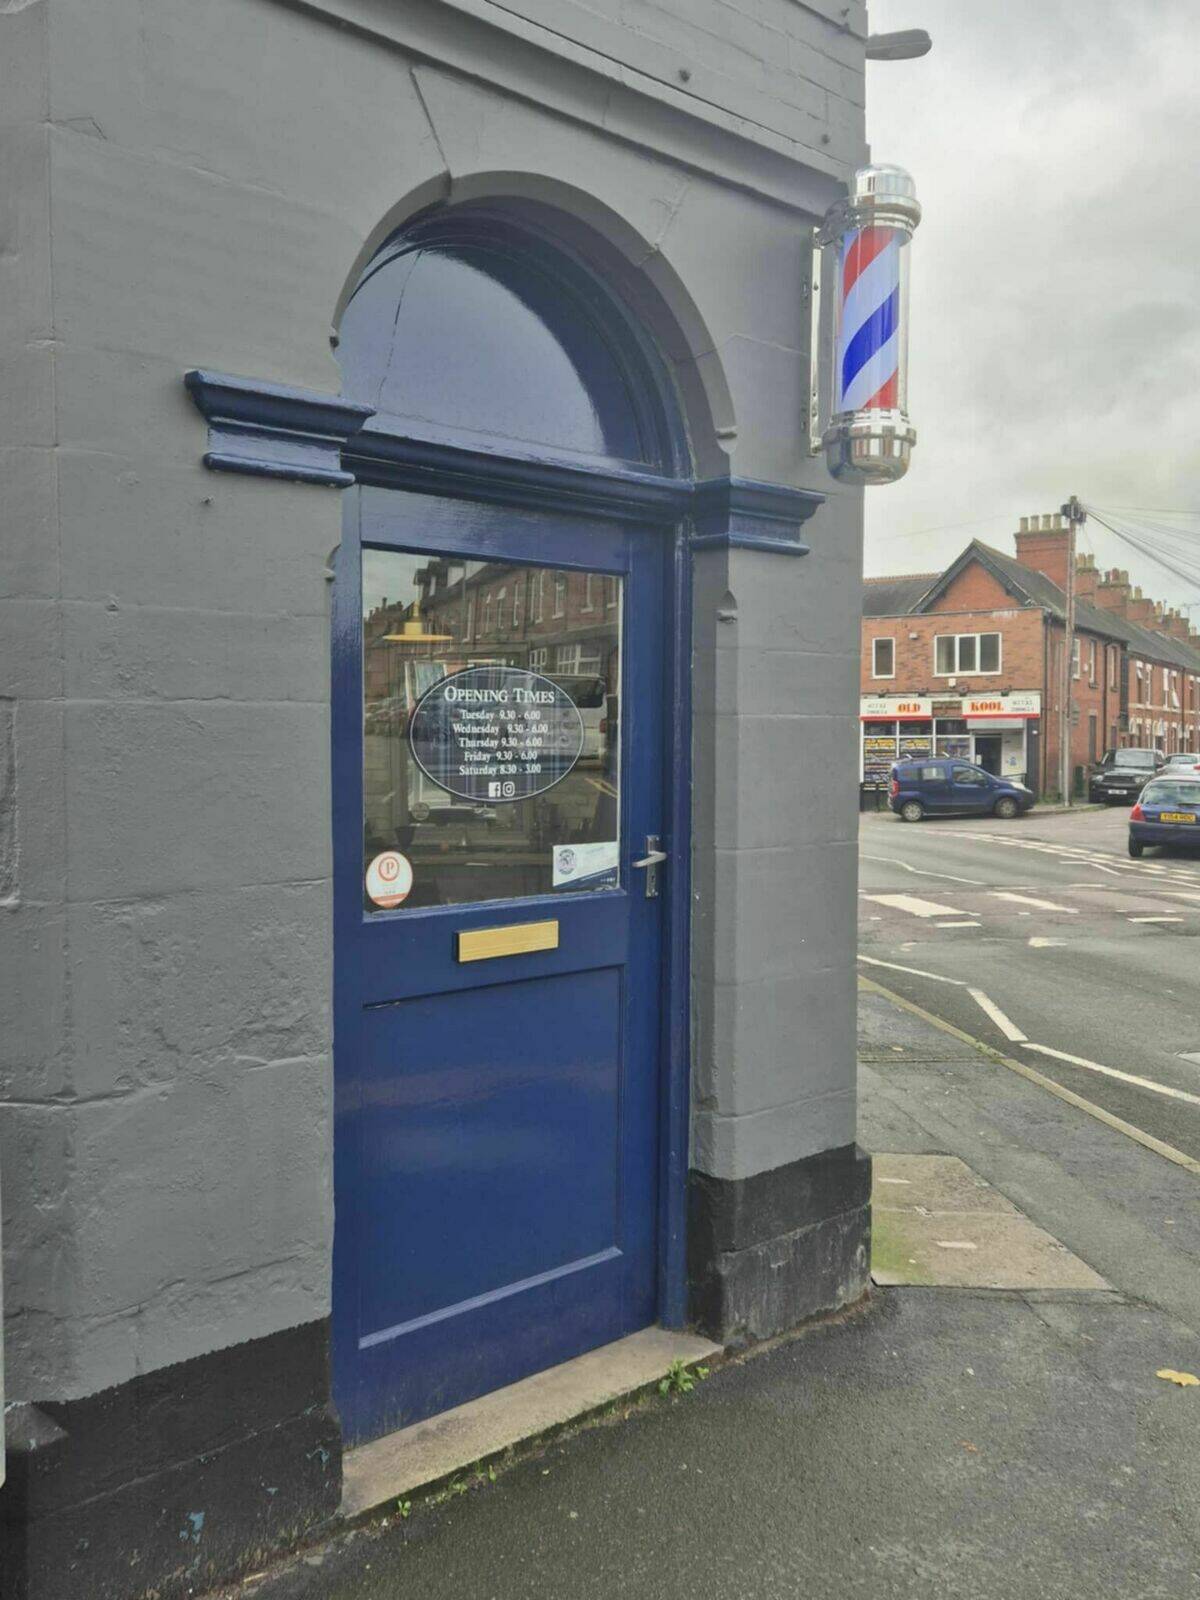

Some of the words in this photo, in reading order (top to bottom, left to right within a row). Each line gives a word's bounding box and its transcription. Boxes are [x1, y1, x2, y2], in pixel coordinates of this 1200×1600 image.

[444, 686, 508, 702] OPENING
[513, 687, 555, 703] TIMES
[897, 702, 921, 713] OLD
[461, 710, 495, 721] Tuesday
[499, 710, 516, 720] 9.30
[524, 710, 541, 720] 6.00
[453, 724, 500, 736] Wednesday
[507, 724, 524, 734] 9.30
[532, 724, 549, 734] 6.00
[458, 738, 499, 748] Thursday
[501, 737, 518, 747] 9.30
[525, 737, 543, 747] 6.00
[464, 751, 491, 763] Friday
[496, 751, 513, 761] 9.30
[521, 751, 538, 761] 6.00
[459, 765, 498, 776] Saturday
[500, 764, 517, 774] 8.30
[525, 764, 542, 774] 3.00
